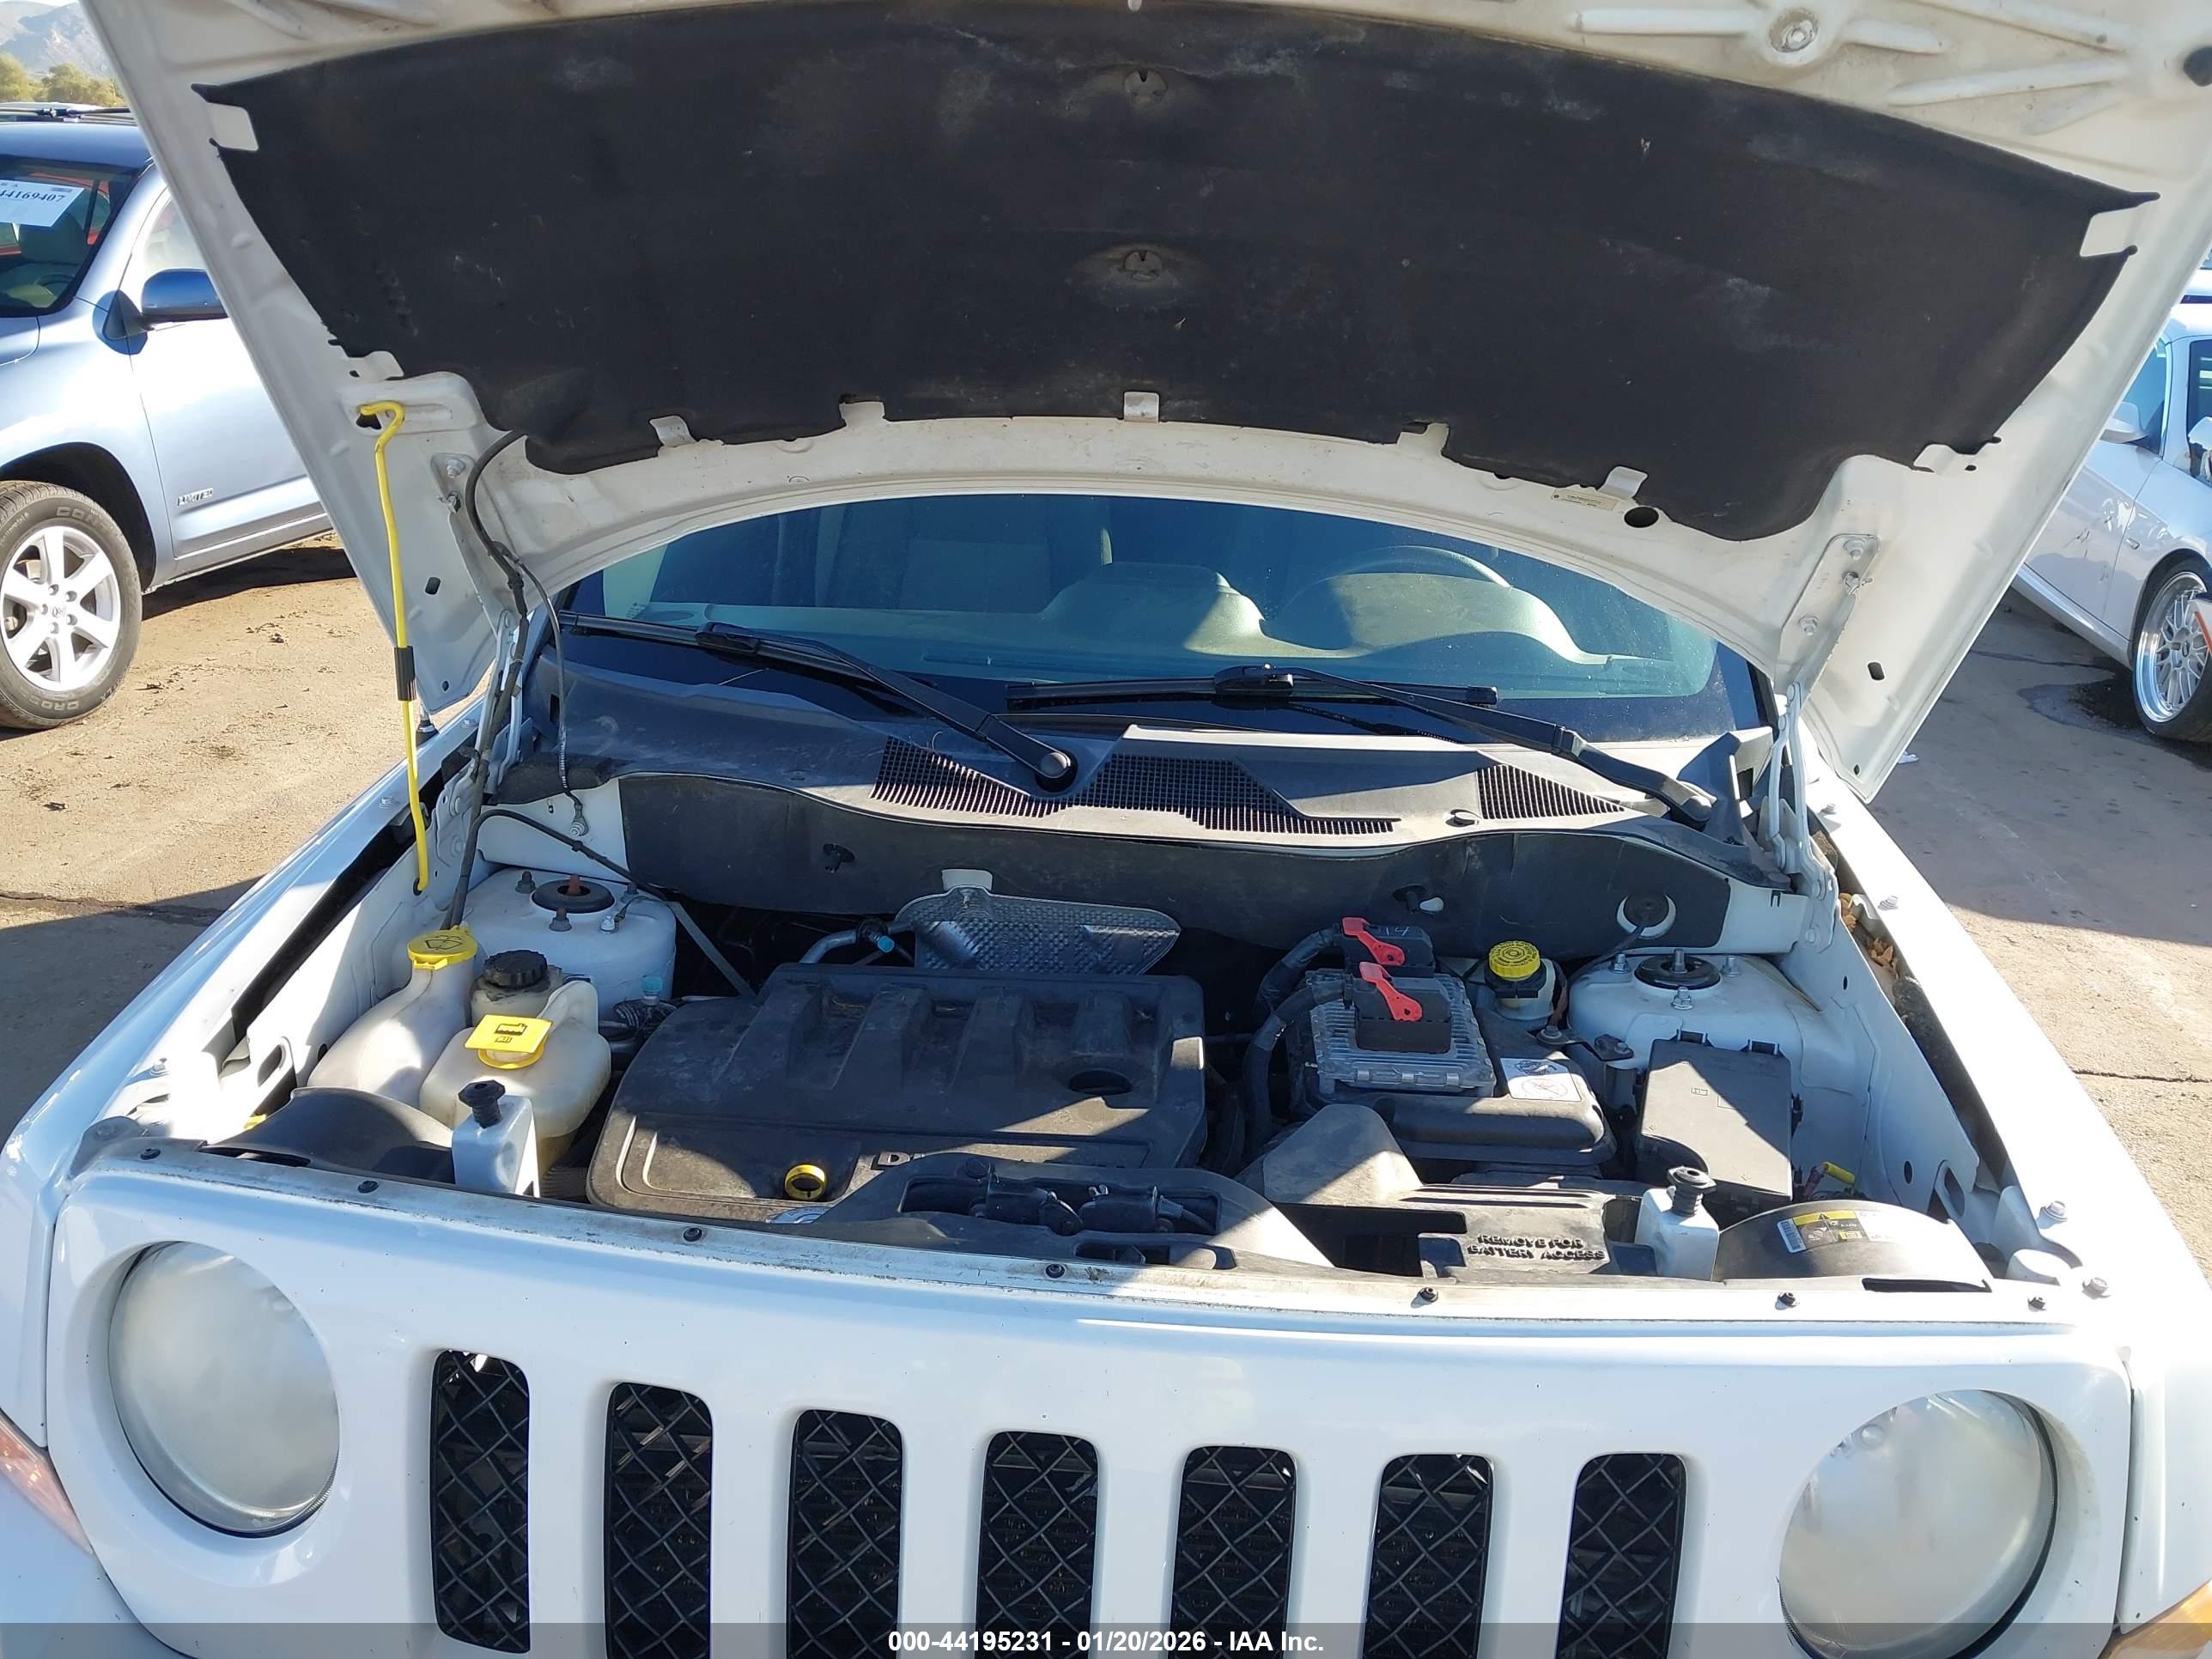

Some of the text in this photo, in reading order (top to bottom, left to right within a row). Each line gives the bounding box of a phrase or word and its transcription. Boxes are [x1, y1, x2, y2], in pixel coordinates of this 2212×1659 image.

[1477, 1234, 1583, 1249] REMOVE FOR
[1467, 1244, 1606, 1261] BATTERY ACCESS
